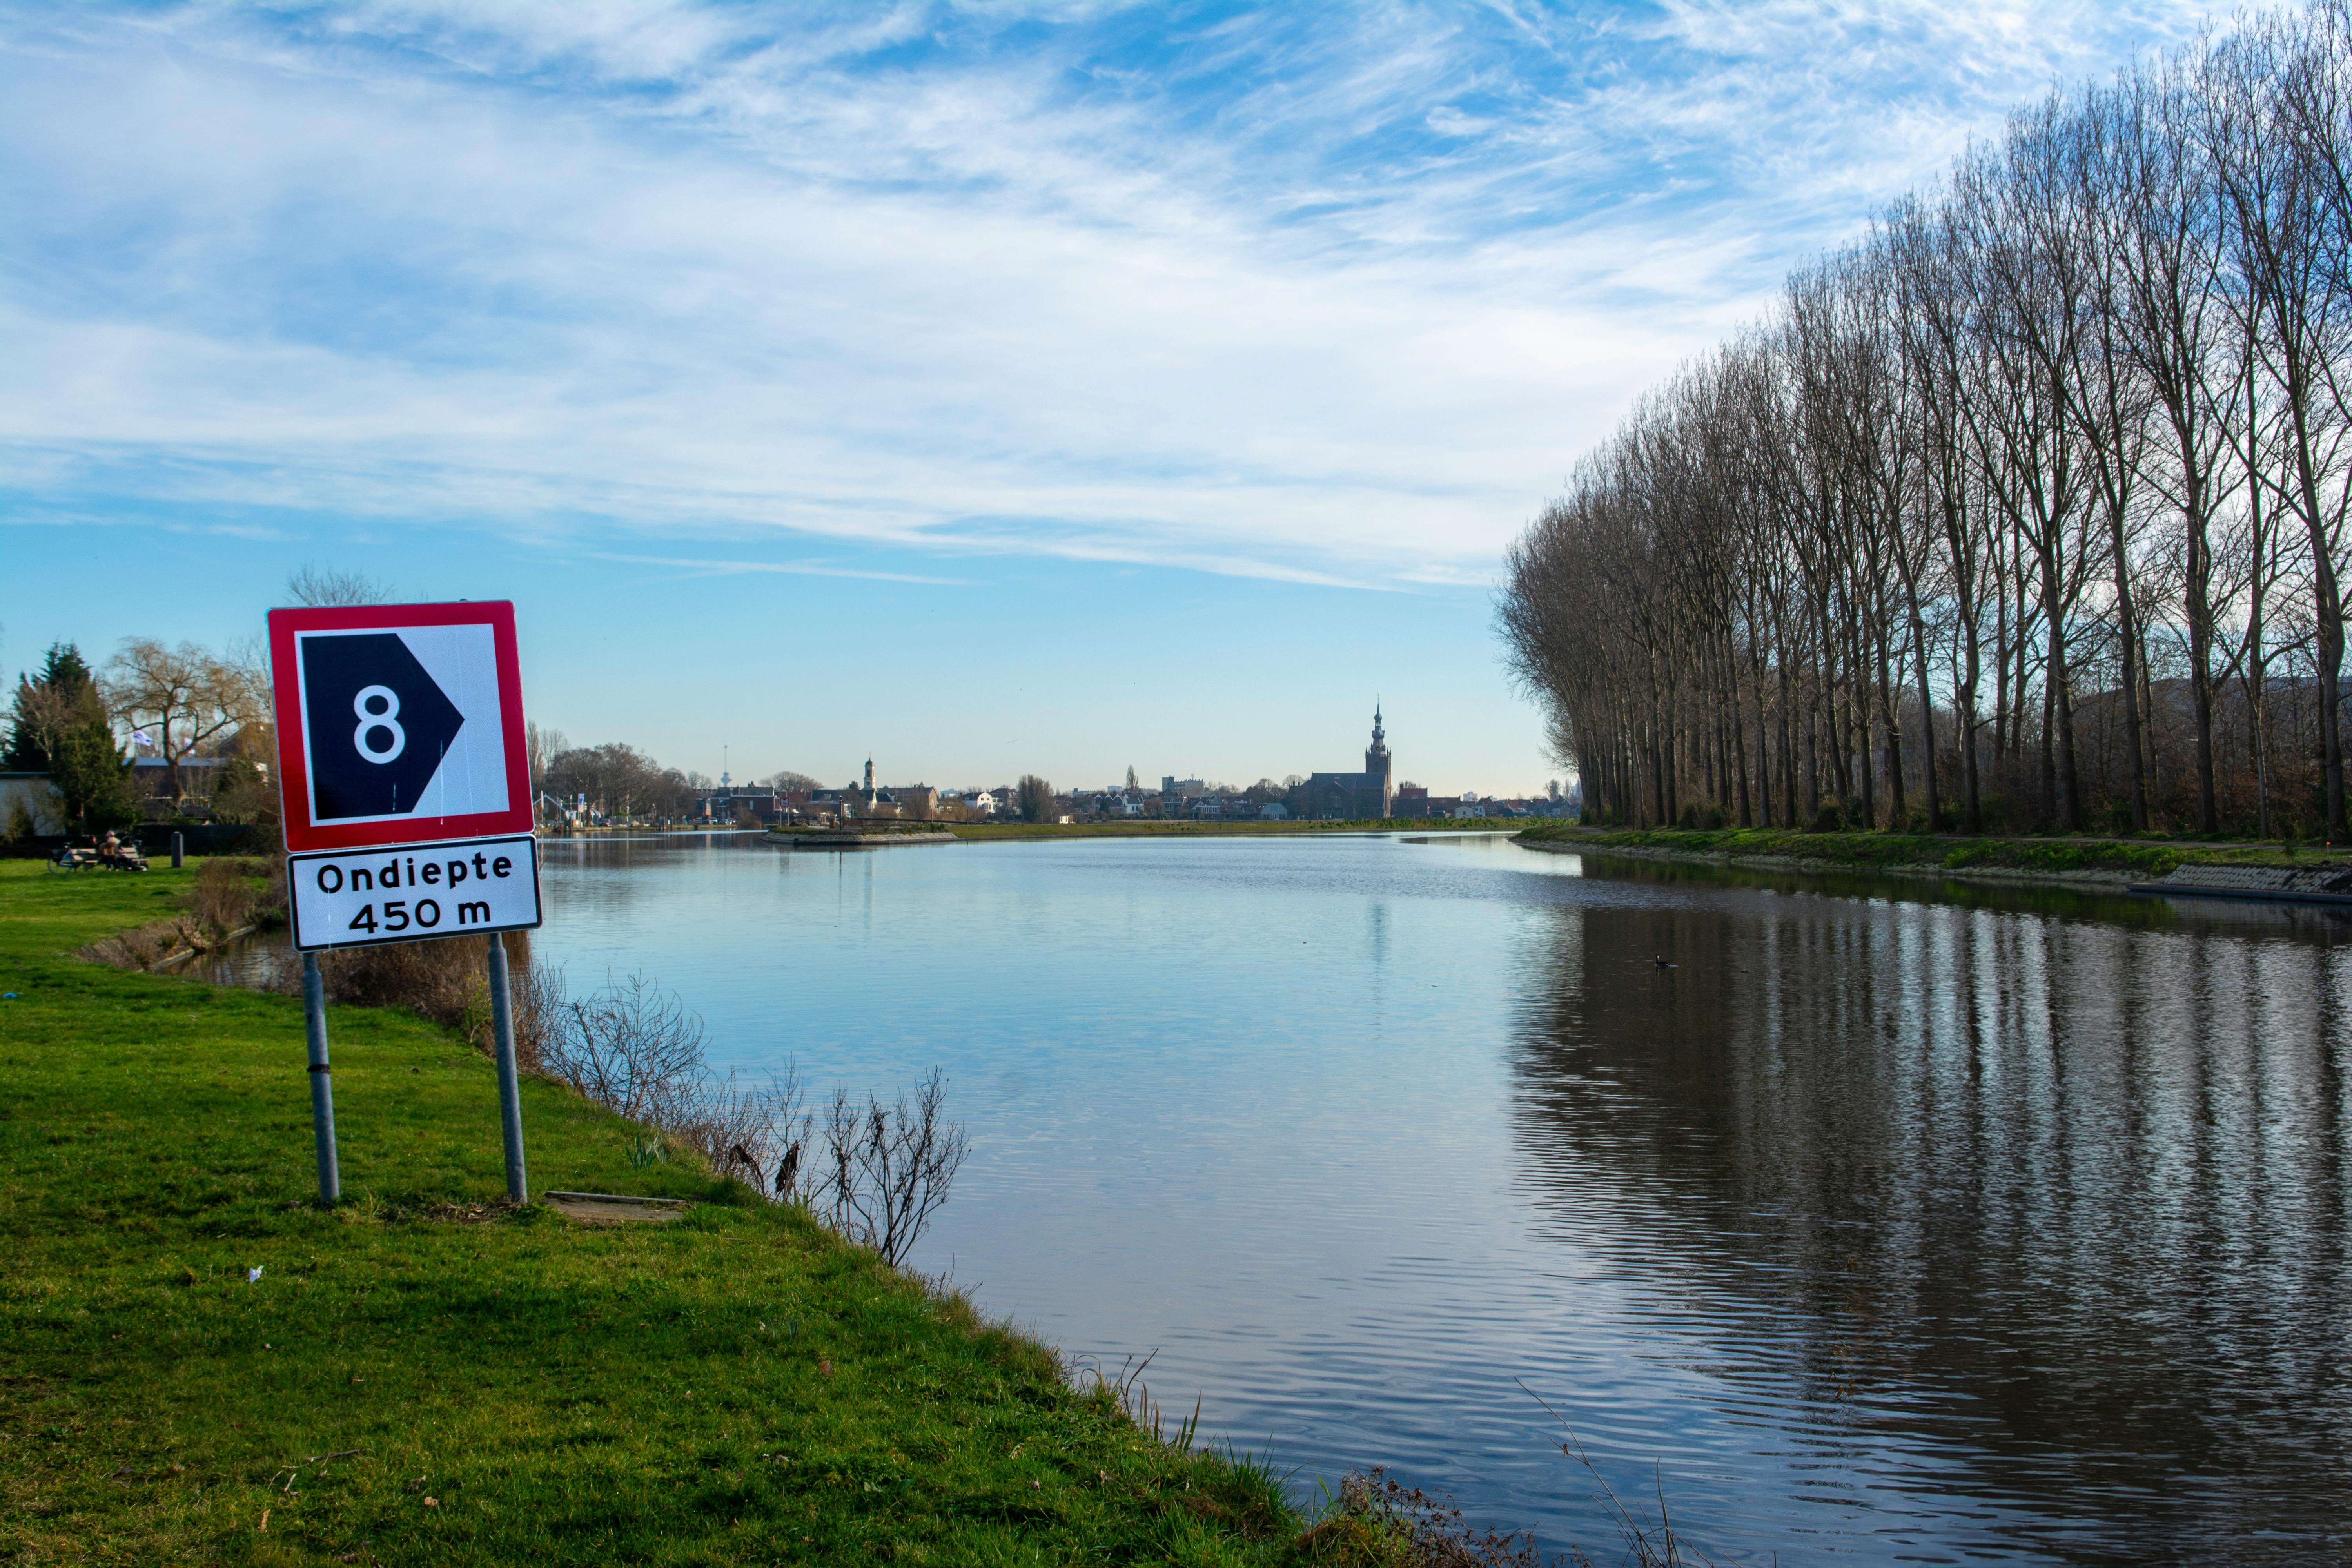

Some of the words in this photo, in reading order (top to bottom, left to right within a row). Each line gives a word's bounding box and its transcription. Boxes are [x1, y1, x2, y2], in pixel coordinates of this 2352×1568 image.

[354, 685, 405, 764] 8
[317, 852, 512, 894] Ondiepte
[348, 899, 441, 934] 450
[458, 901, 490, 925] m
